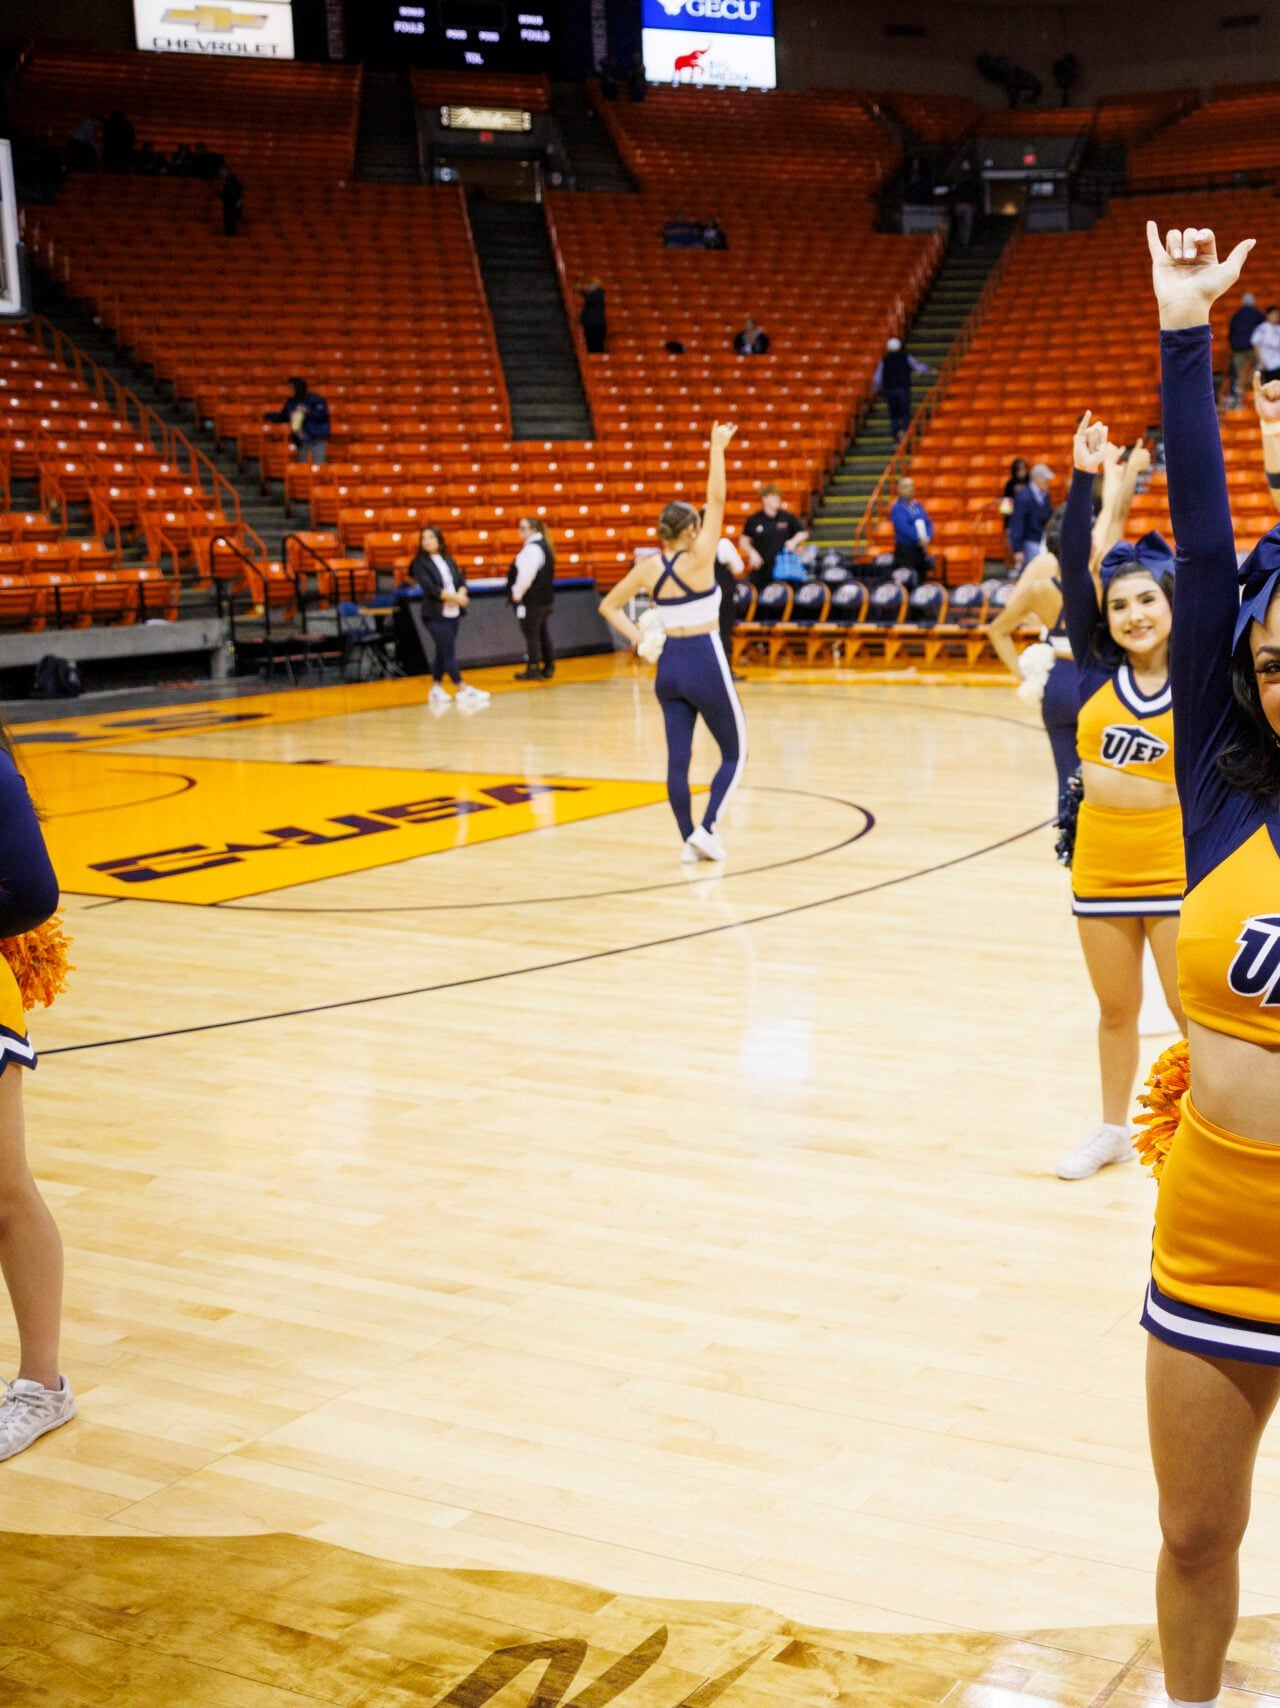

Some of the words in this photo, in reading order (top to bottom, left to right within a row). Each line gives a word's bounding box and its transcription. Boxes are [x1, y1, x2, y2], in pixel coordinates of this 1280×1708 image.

[685, 0, 757, 20] GECU
[394, 20, 425, 34] FOULS
[521, 29, 550, 42] FOULS
[152, 37, 281, 57] CHEVROLET
[1102, 724, 1169, 769] UTEP
